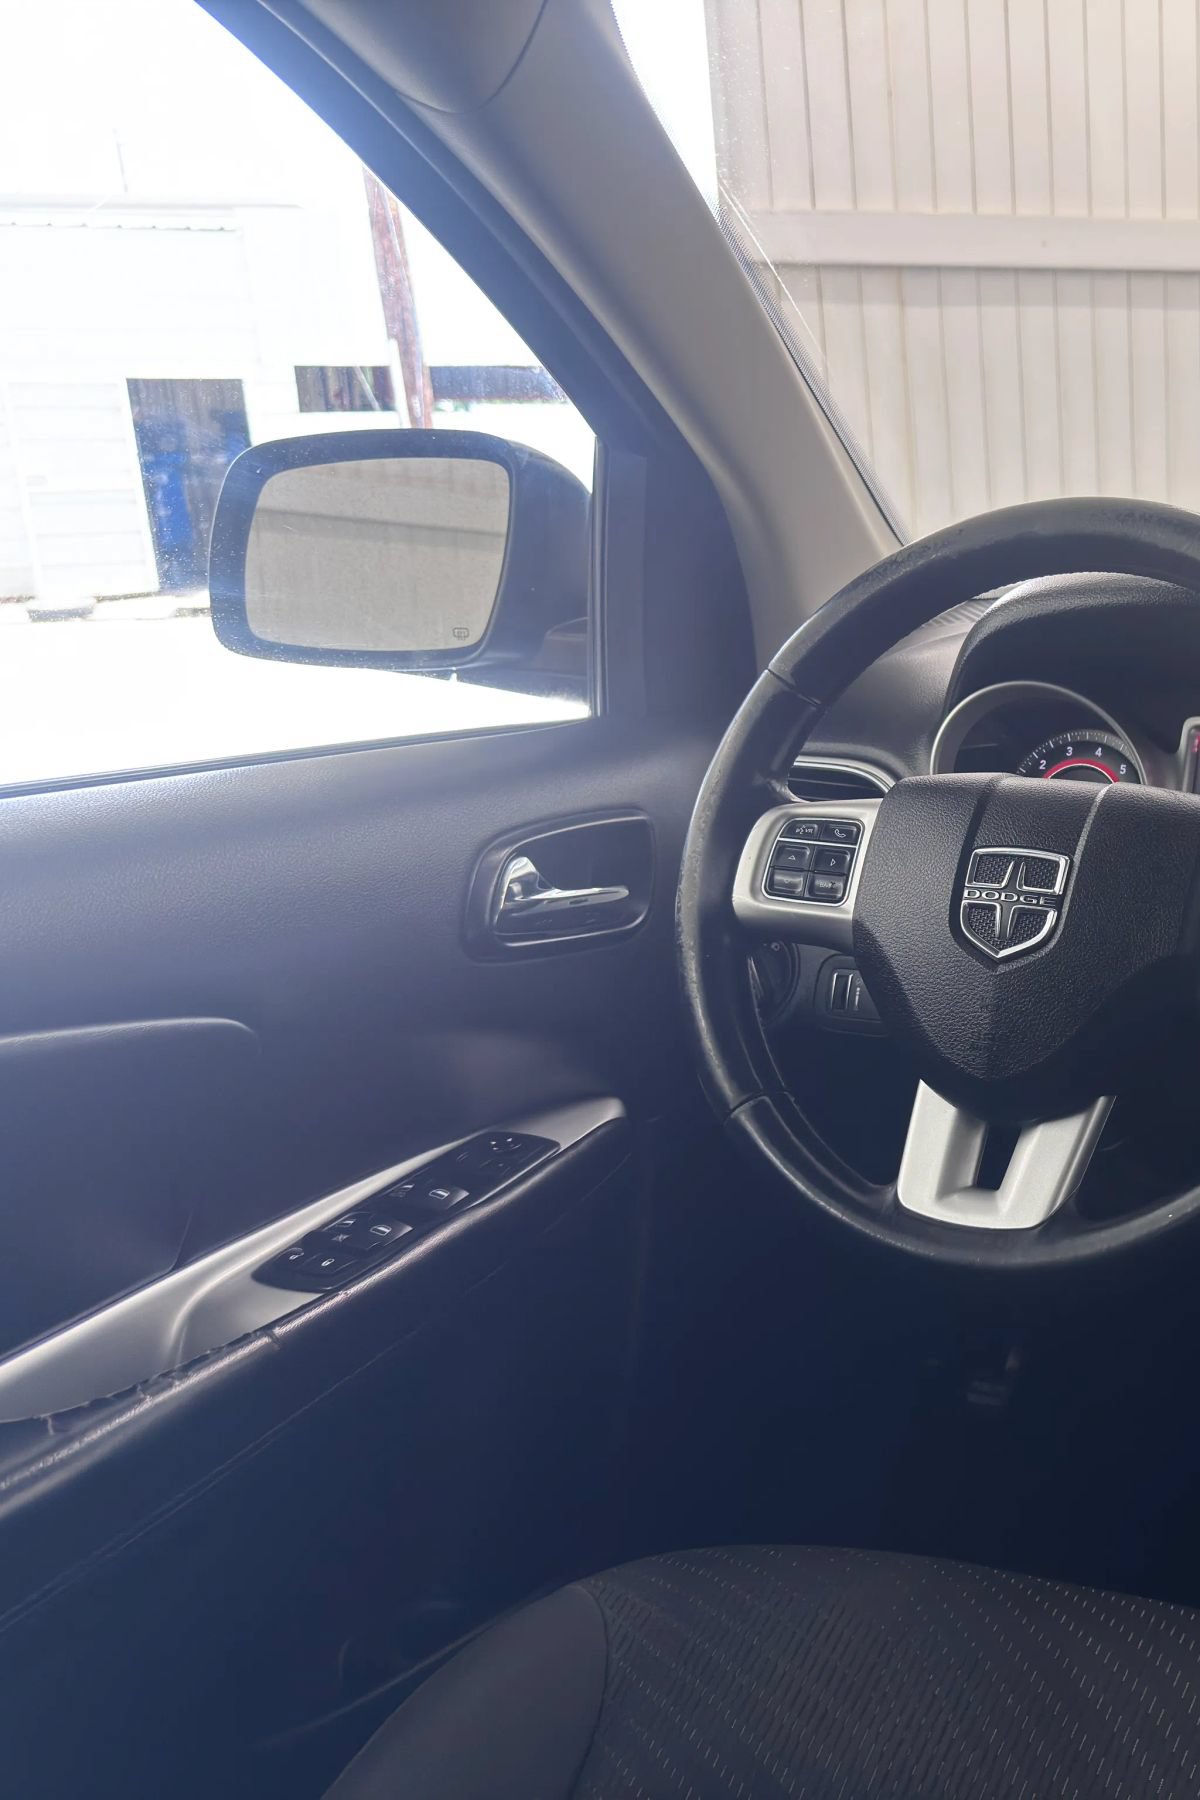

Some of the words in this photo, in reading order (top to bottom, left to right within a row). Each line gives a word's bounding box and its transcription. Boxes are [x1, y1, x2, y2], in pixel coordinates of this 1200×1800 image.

[1066, 747, 1073, 757] 3
[1095, 747, 1102, 758] 4
[1039, 760, 1047, 770] 2
[1119, 764, 1127, 775] 5
[963, 889, 1057, 907] DODGE
